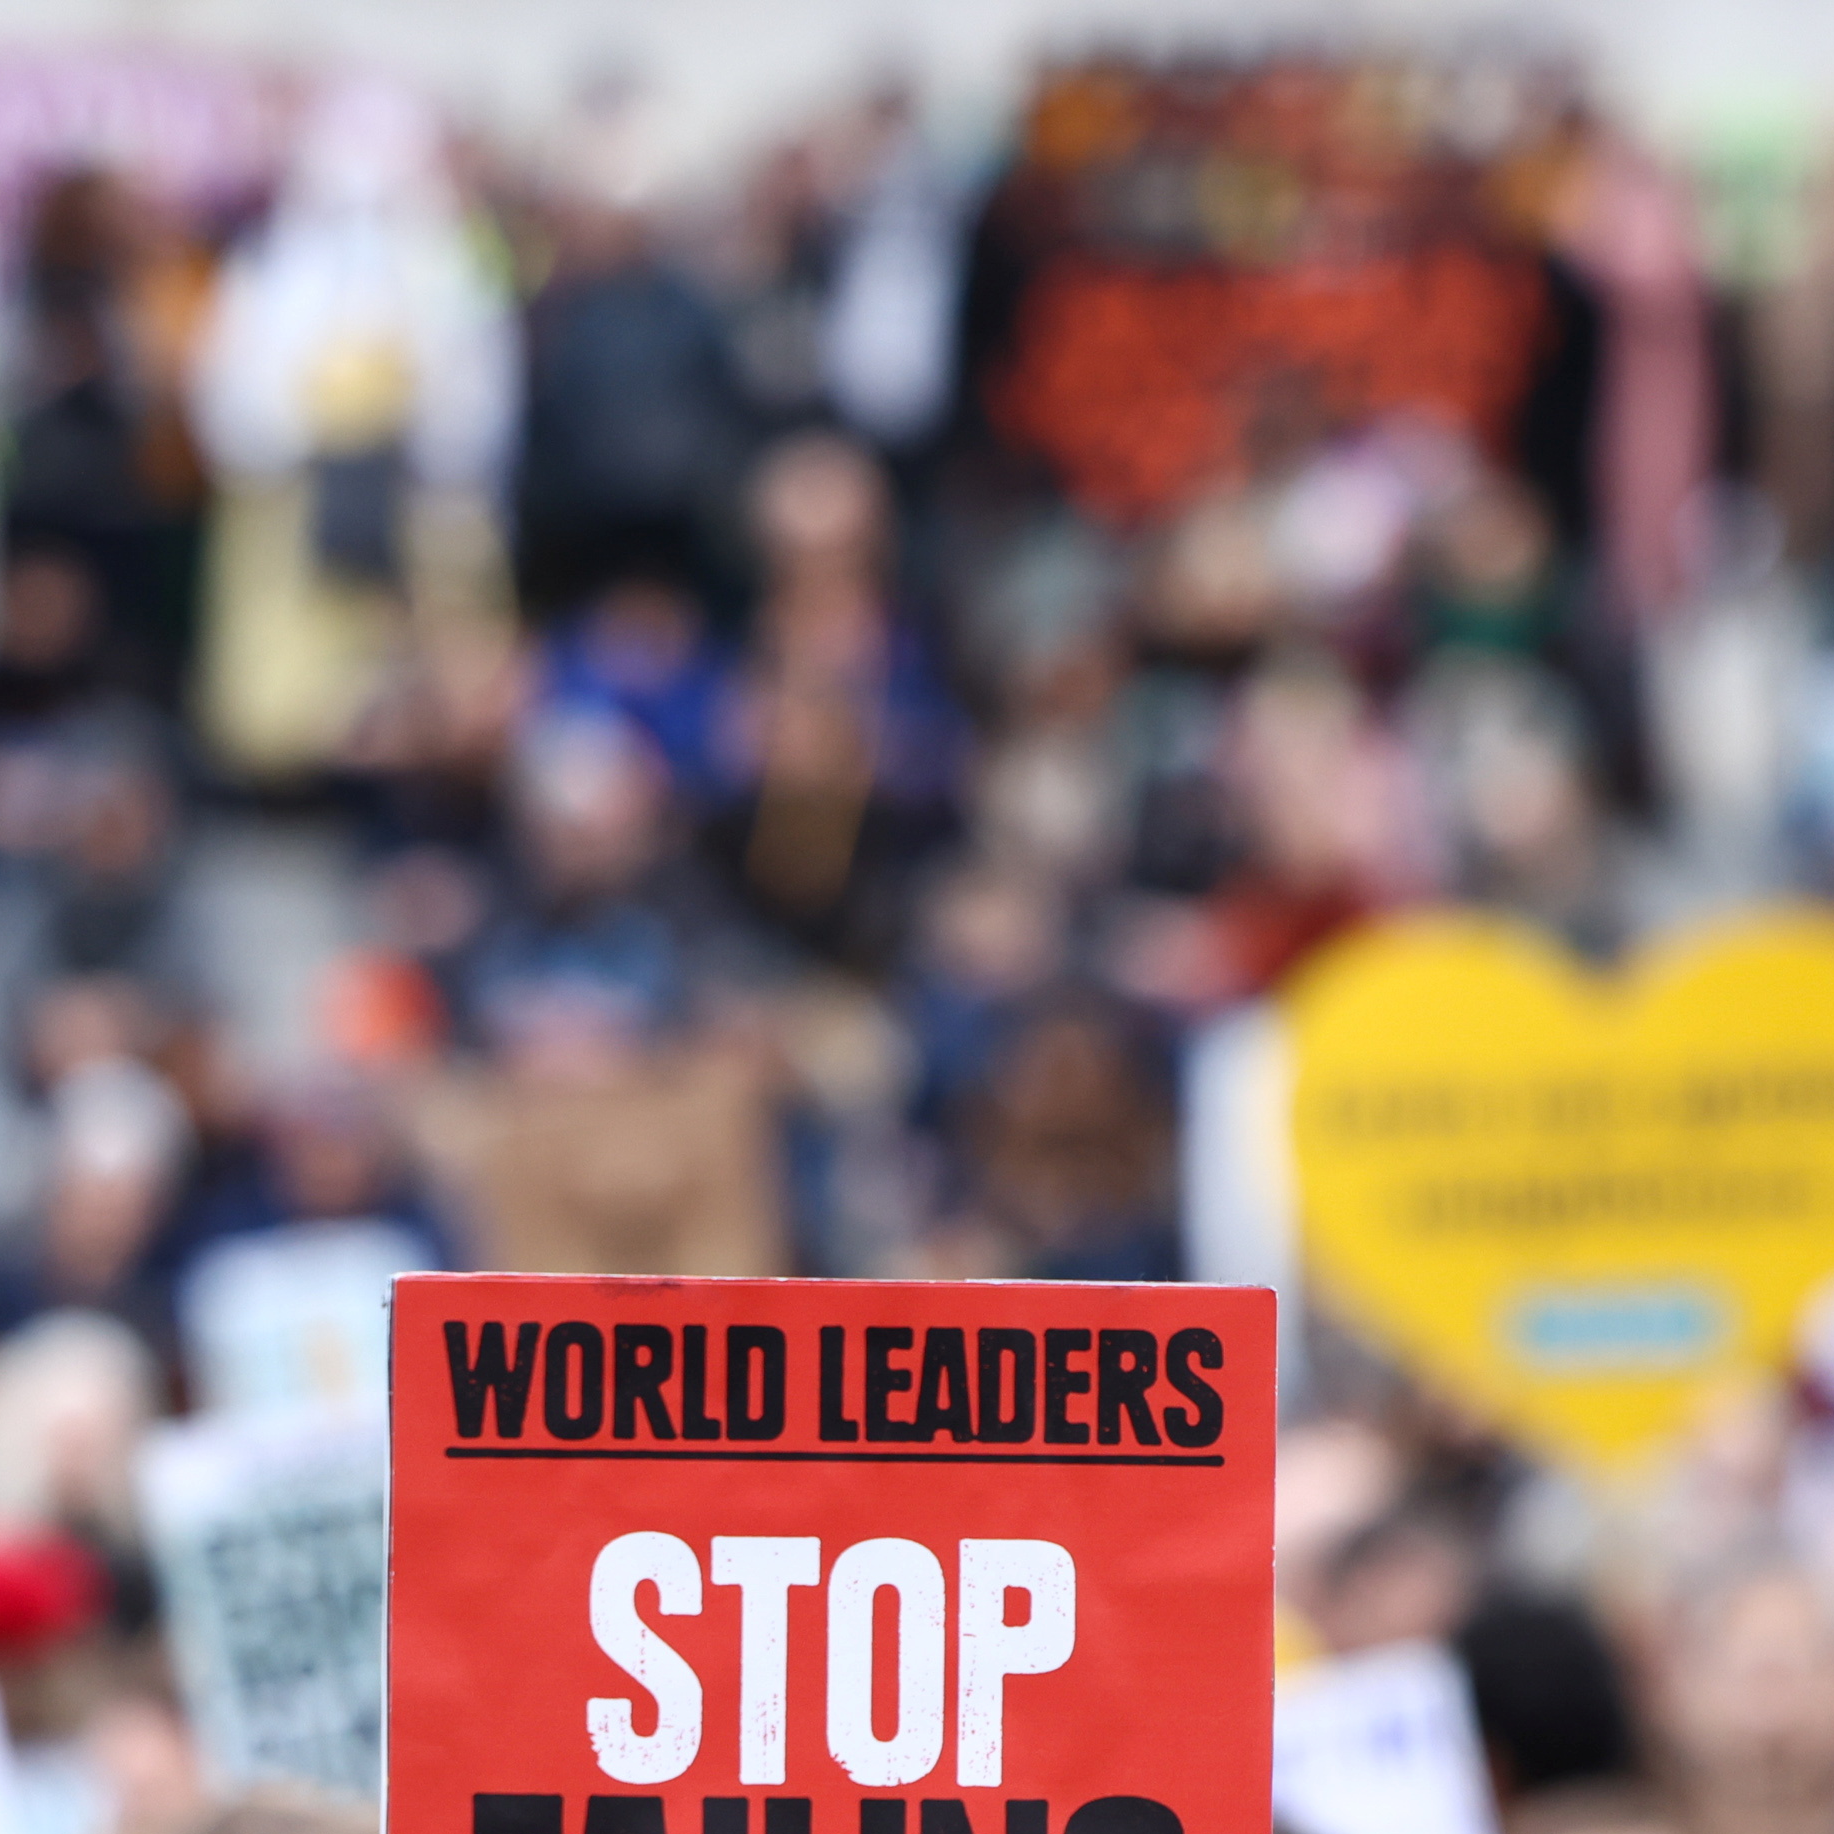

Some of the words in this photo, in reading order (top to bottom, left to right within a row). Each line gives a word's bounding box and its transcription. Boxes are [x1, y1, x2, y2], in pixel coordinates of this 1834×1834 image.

[443, 1320, 787, 1441] WORLD
[818, 1325, 1224, 1449] LEADERS
[586, 1530, 1077, 1788] STOP
